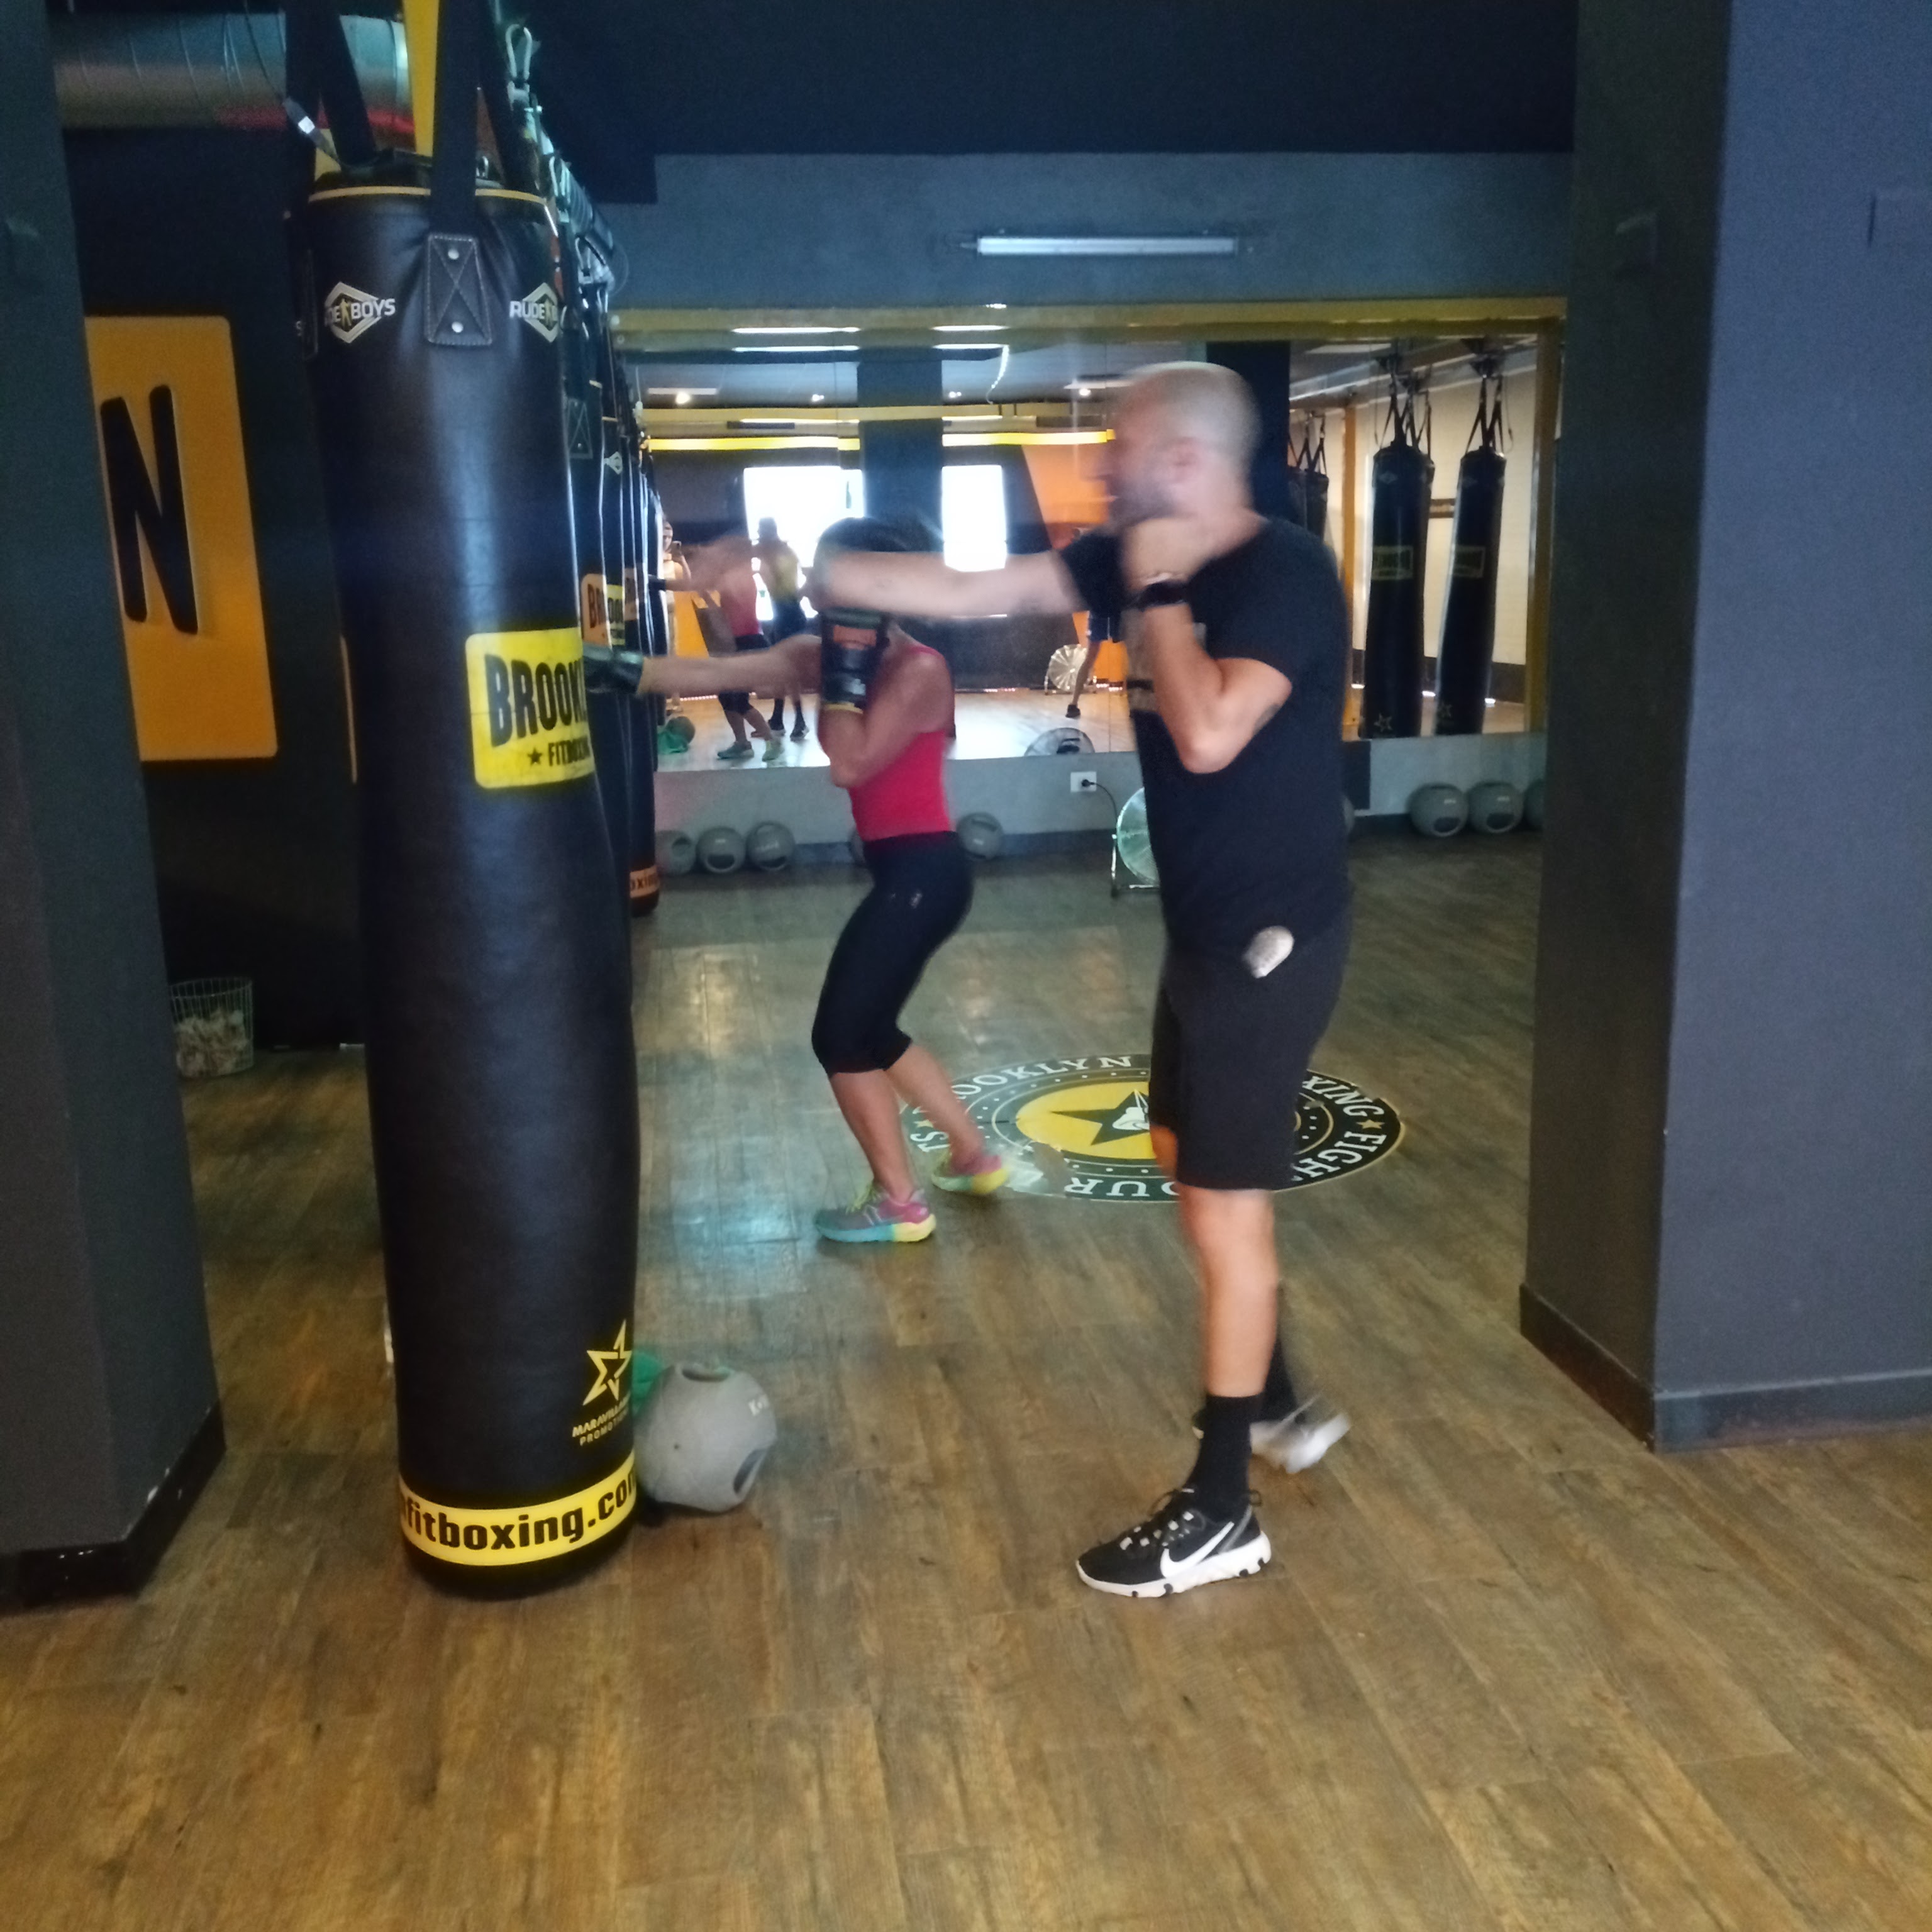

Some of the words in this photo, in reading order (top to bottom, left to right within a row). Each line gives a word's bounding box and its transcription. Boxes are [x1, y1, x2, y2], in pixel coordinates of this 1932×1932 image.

[351, 298, 396, 319] BOYS
[509, 301, 545, 319] RUDE
[947, 1055, 1132, 1101] OOKLYN
[1302, 1075, 1385, 1117] XING
[1291, 1131, 1387, 1181] FIGH
